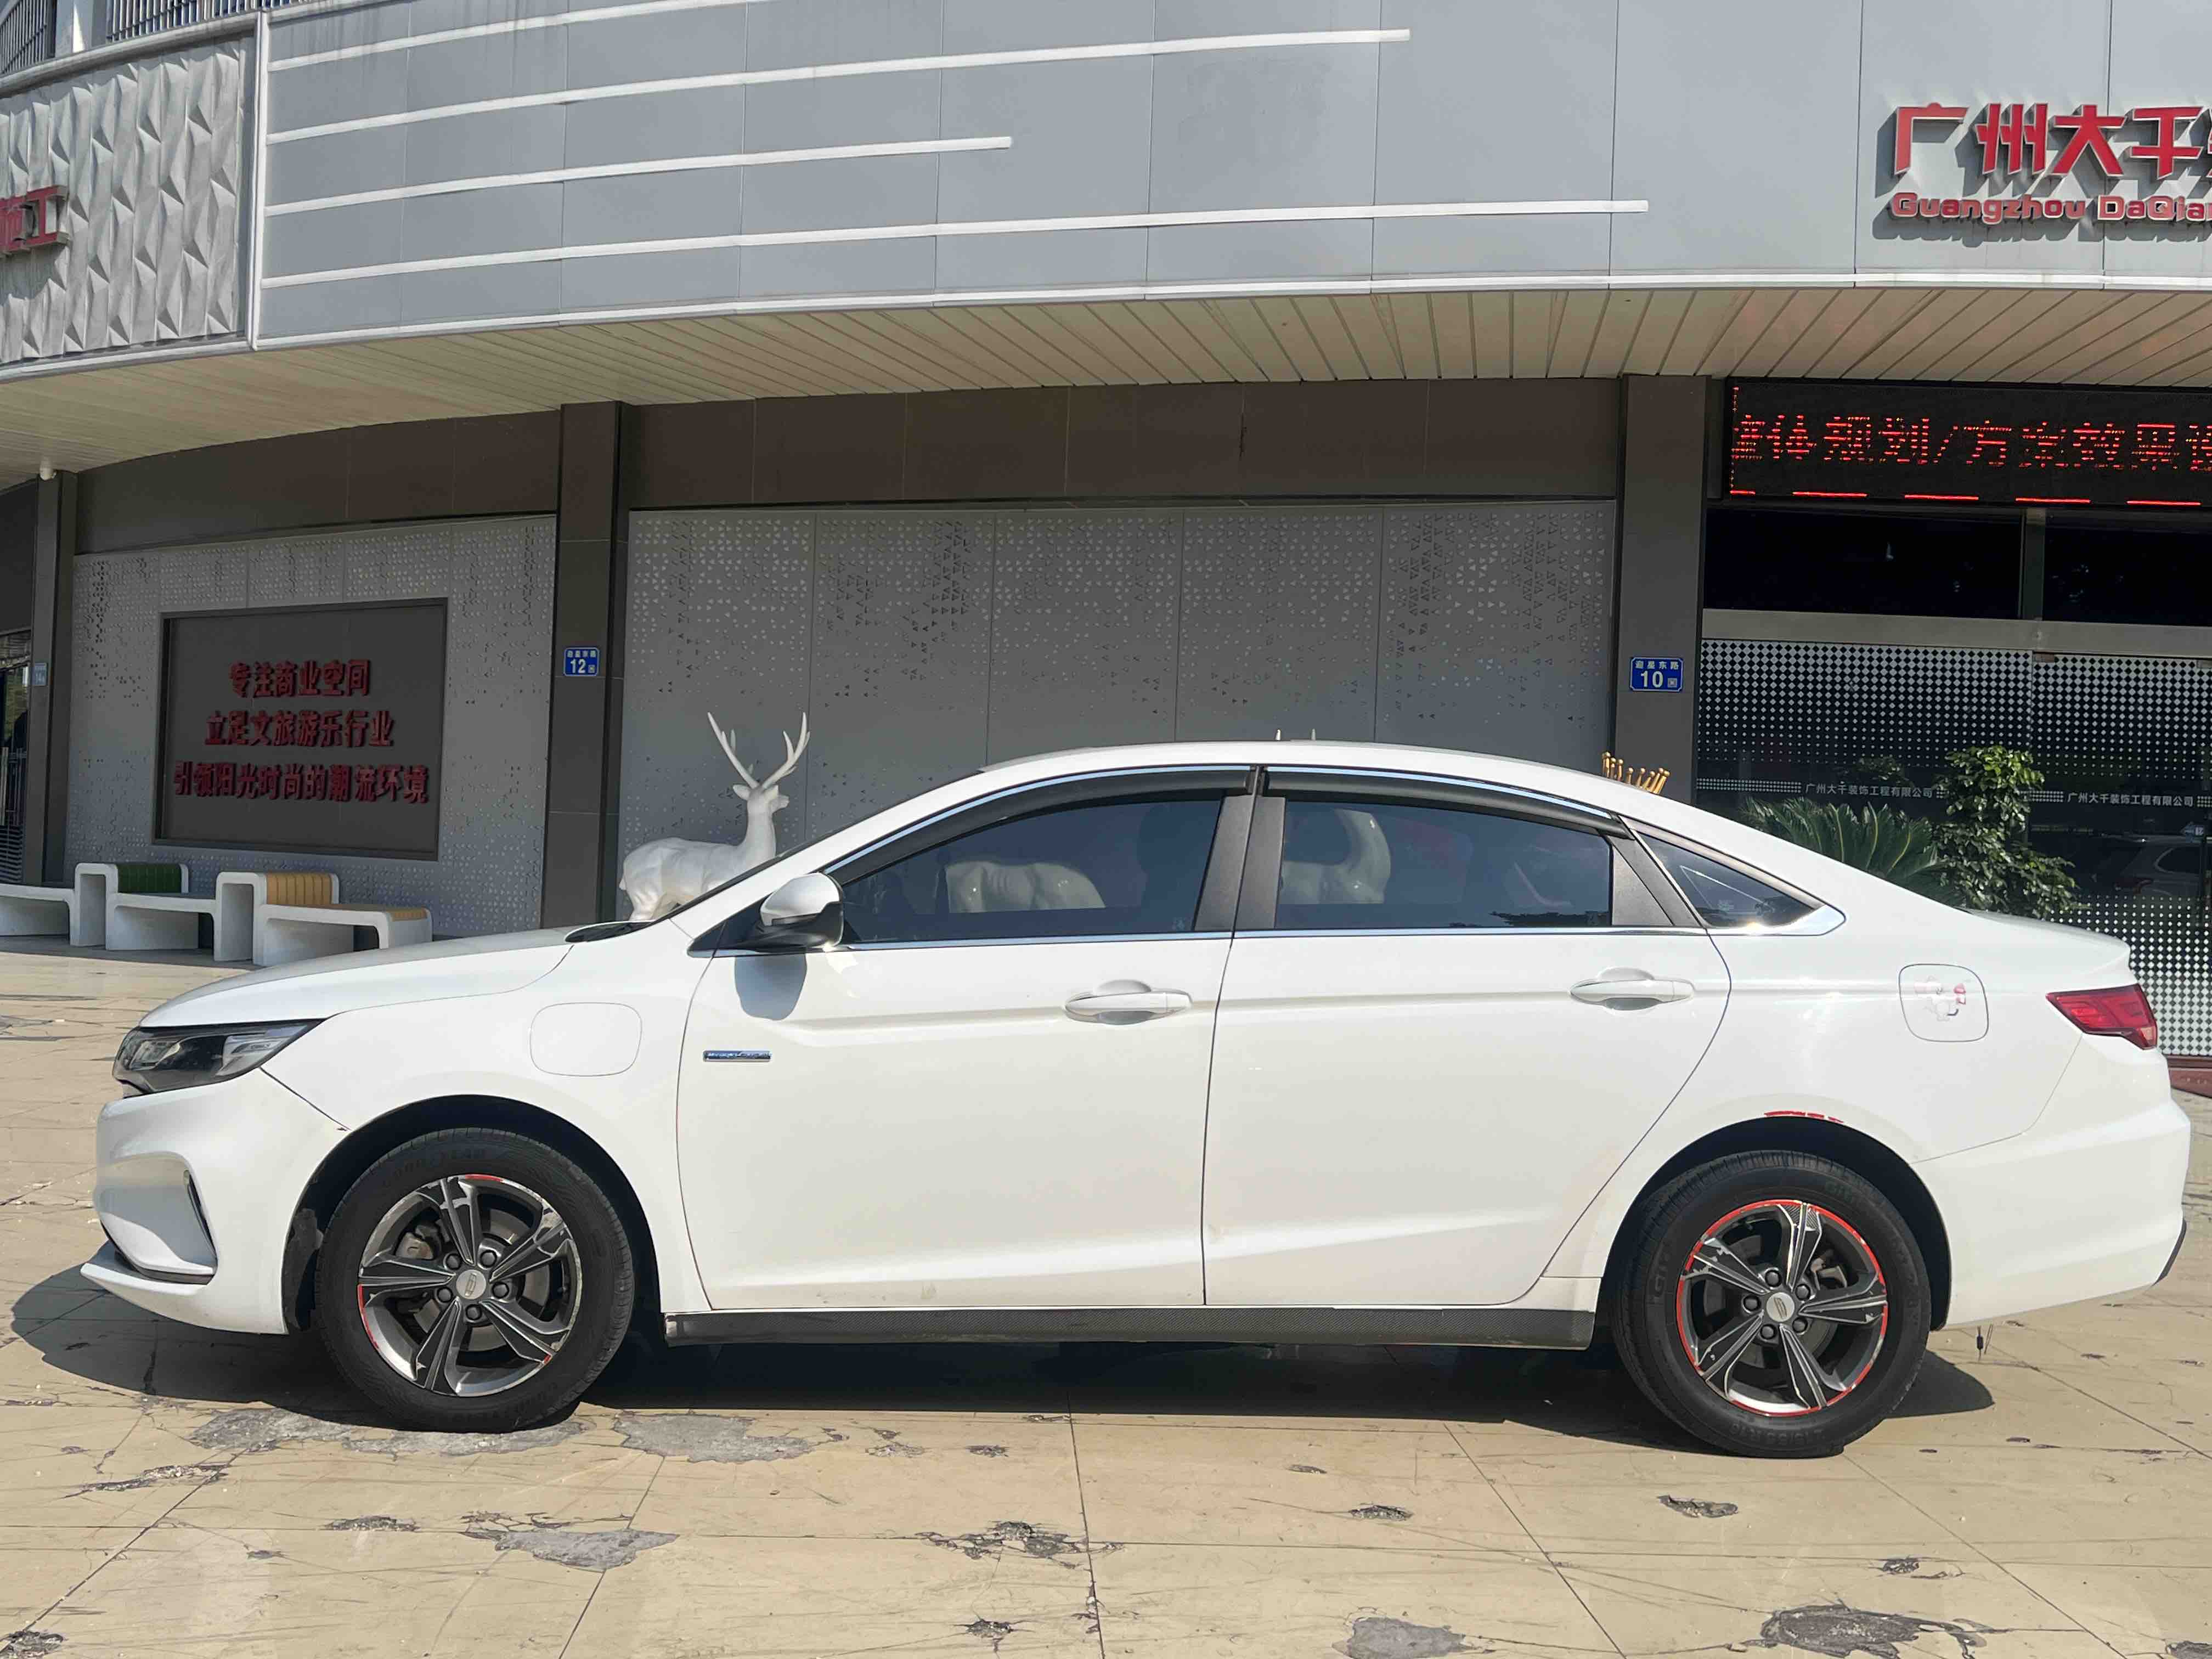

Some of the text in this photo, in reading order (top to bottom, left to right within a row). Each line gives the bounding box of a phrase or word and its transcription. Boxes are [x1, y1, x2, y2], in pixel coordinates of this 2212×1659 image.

[1894, 103, 2212, 179] 广州大千
[1891, 192, 2212, 223] Guangzhou DaQia
[229, 659, 370, 698] 专注商业空间
[1641, 670, 1663, 687] 10
[205, 710, 394, 747] 立足文旅游乐行业
[174, 761, 428, 803] 引领阳光时尚的潮流环境
[1805, 782, 1933, 798] 广州大千装饰工程有限公司
[2067, 792, 2194, 807] 广州大千装饰工程有限公司
